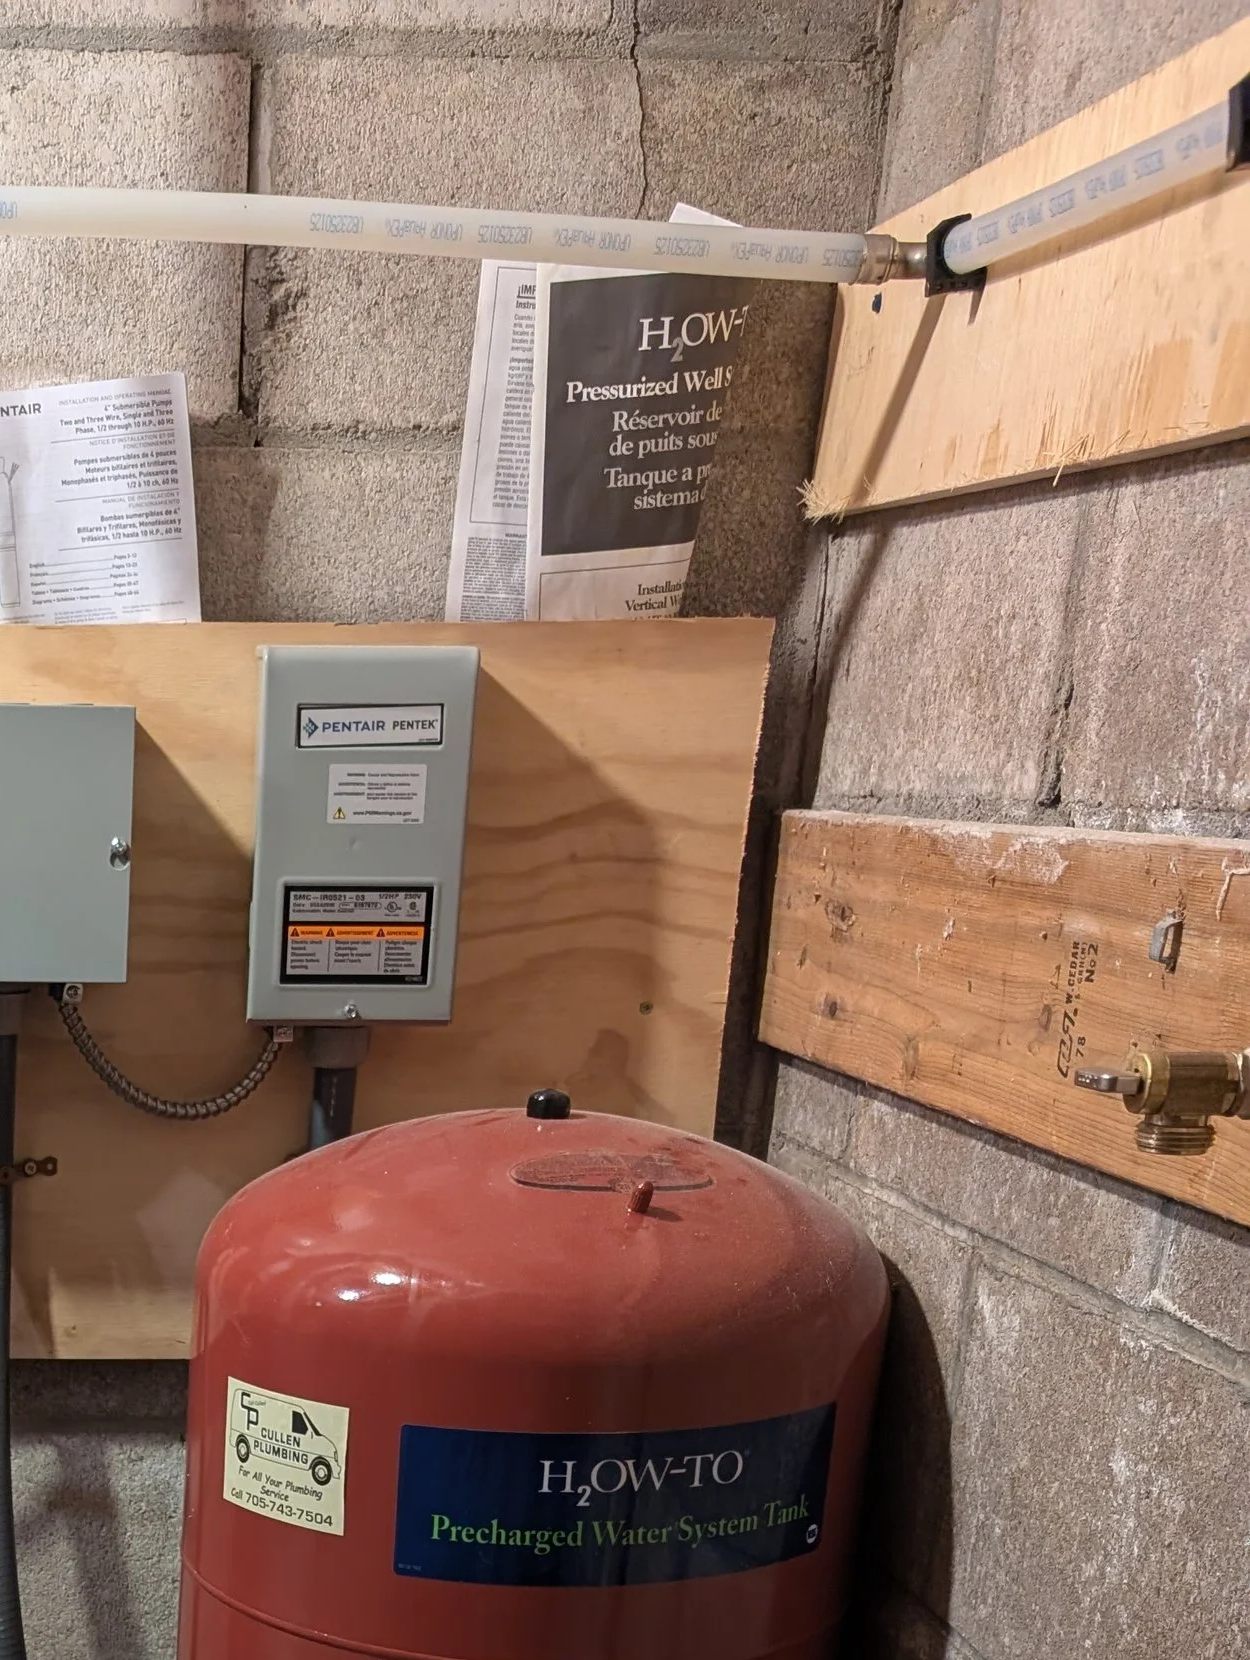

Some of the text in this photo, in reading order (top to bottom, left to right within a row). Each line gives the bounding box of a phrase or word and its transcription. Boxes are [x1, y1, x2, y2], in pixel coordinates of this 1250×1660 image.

[431, 223, 463, 241] UPONOR
[566, 372, 678, 402] Pressurized
[684, 366, 723, 392] Well
[59, 396, 99, 405] INSTALLATION
[112, 400, 150, 411] Submersible
[152, 399, 172, 407] Pumps
[123, 411, 141, 420] Single
[613, 400, 722, 432] Réservoir de
[108, 423, 132, 431] through
[609, 434, 633, 456] de
[638, 431, 683, 459] puits
[74, 457, 98, 466] Pompes
[100, 453, 140, 463] submersibles
[156, 450, 177, 458] pouces
[139, 470, 169, 478] Puissance
[604, 468, 677, 489] Tanque
[682, 467, 692, 481] a
[634, 489, 698, 509] sistema
[126, 510, 163, 521] sumergibles
[625, 596, 666, 611] Vertical
[322, 719, 437, 733] PENTAIR PENTEK
[1088, 943, 1098, 956] 2
[261, 1428, 300, 1448] CULLEN
[254, 1440, 308, 1464] PLUMBING
[239, 1466, 323, 1501] For All Your Plumbing
[260, 1486, 289, 1502] Service
[231, 1488, 333, 1526] Call 705-743-7504
[430, 1494, 811, 1555] Precharged Water System Tank
